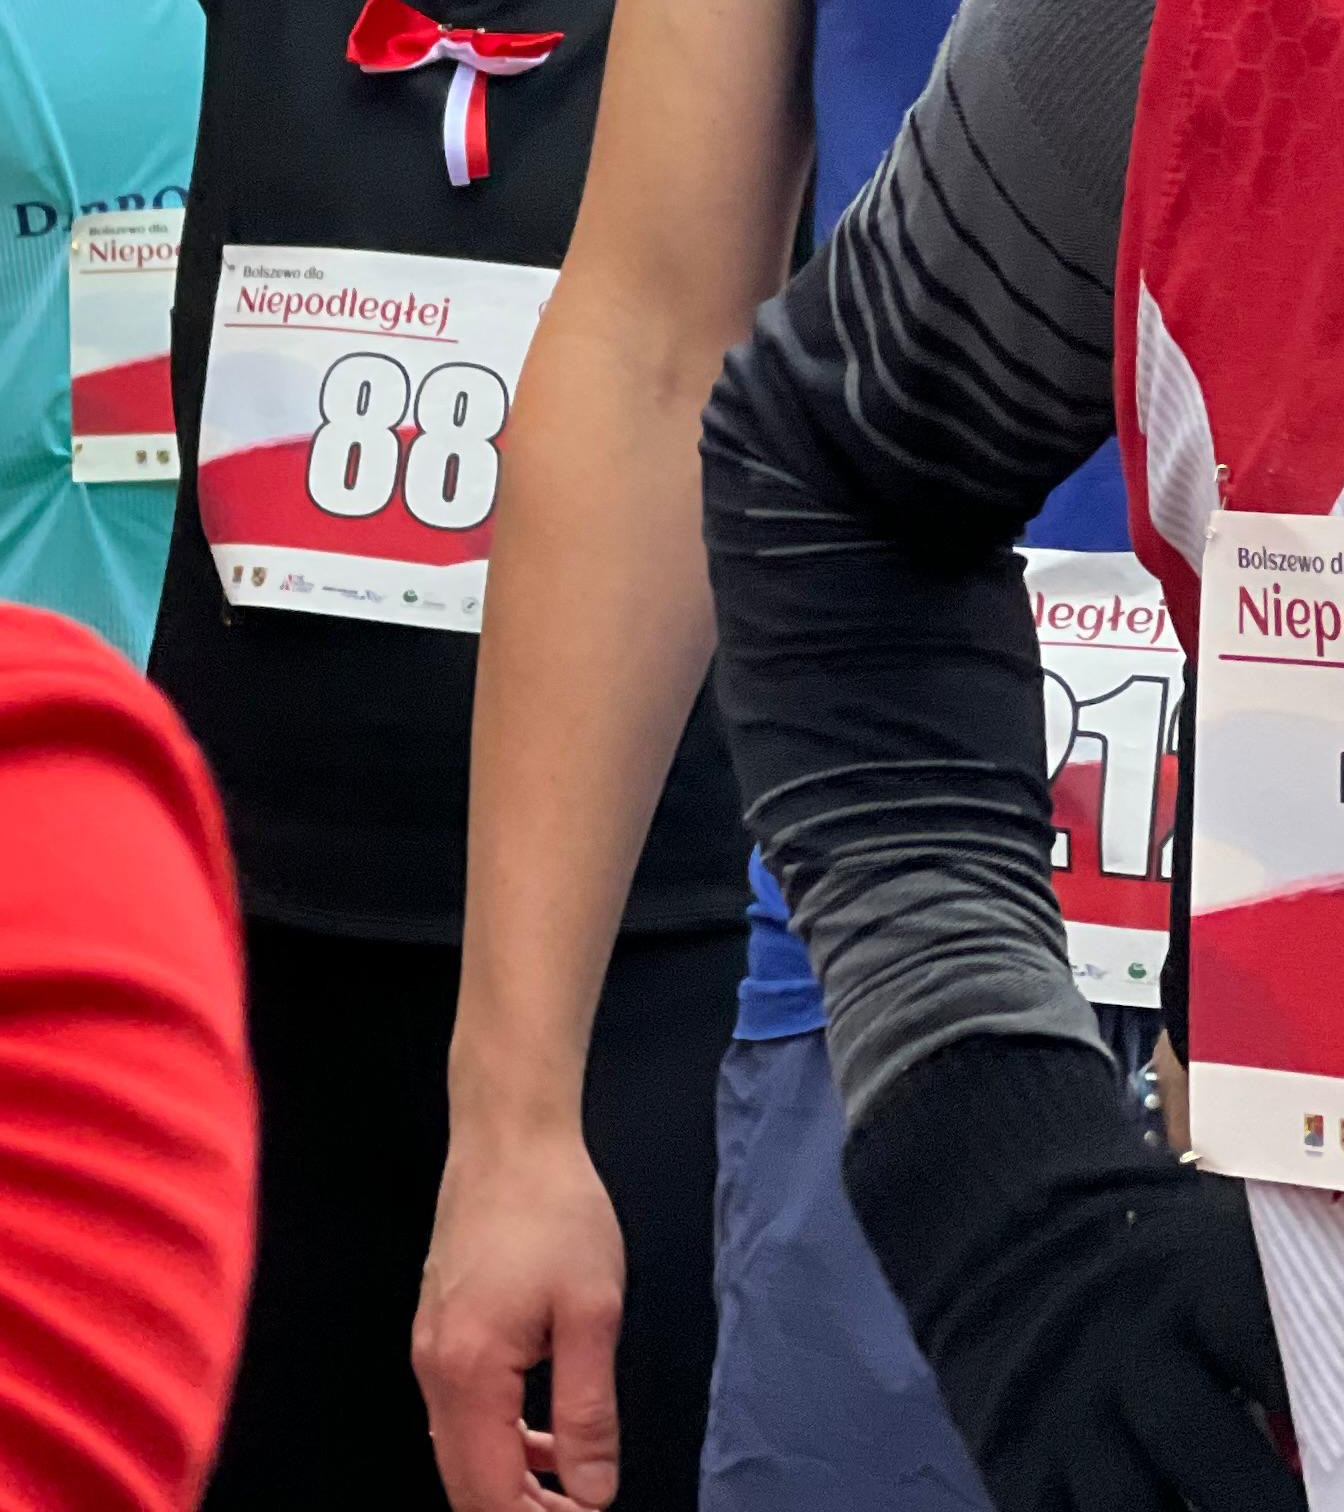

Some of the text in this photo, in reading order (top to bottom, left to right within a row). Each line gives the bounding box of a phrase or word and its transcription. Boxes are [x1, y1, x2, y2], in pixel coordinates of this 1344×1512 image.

[89, 239, 182, 268] Niepo
[243, 264, 324, 281] Bolszewo dla
[237, 285, 452, 337] Niepodległej
[306, 350, 510, 533] 88
[1237, 546, 1324, 575] Bolszewo
